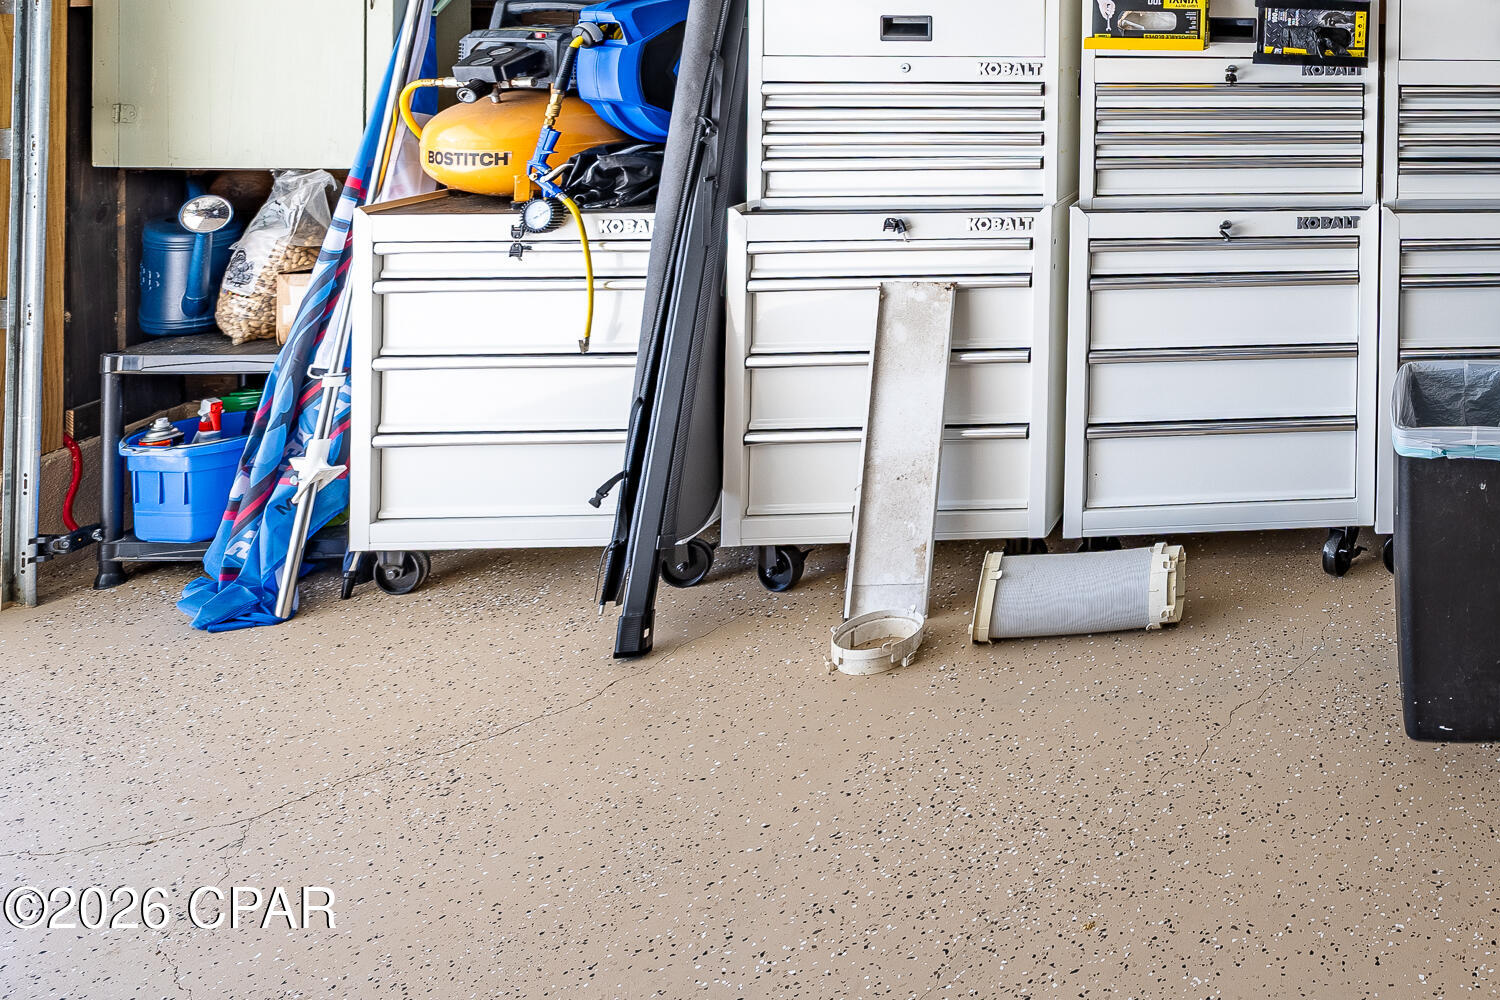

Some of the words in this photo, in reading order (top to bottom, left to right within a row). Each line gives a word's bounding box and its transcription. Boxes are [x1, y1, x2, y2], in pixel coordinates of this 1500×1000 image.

[977, 62, 1043, 76] KOBALT
[1301, 65, 1362, 76] KOBALT
[428, 150, 509, 167] BOSTITCH
[966, 216, 1035, 231] KOBALT
[1296, 215, 1361, 230] KOBALT
